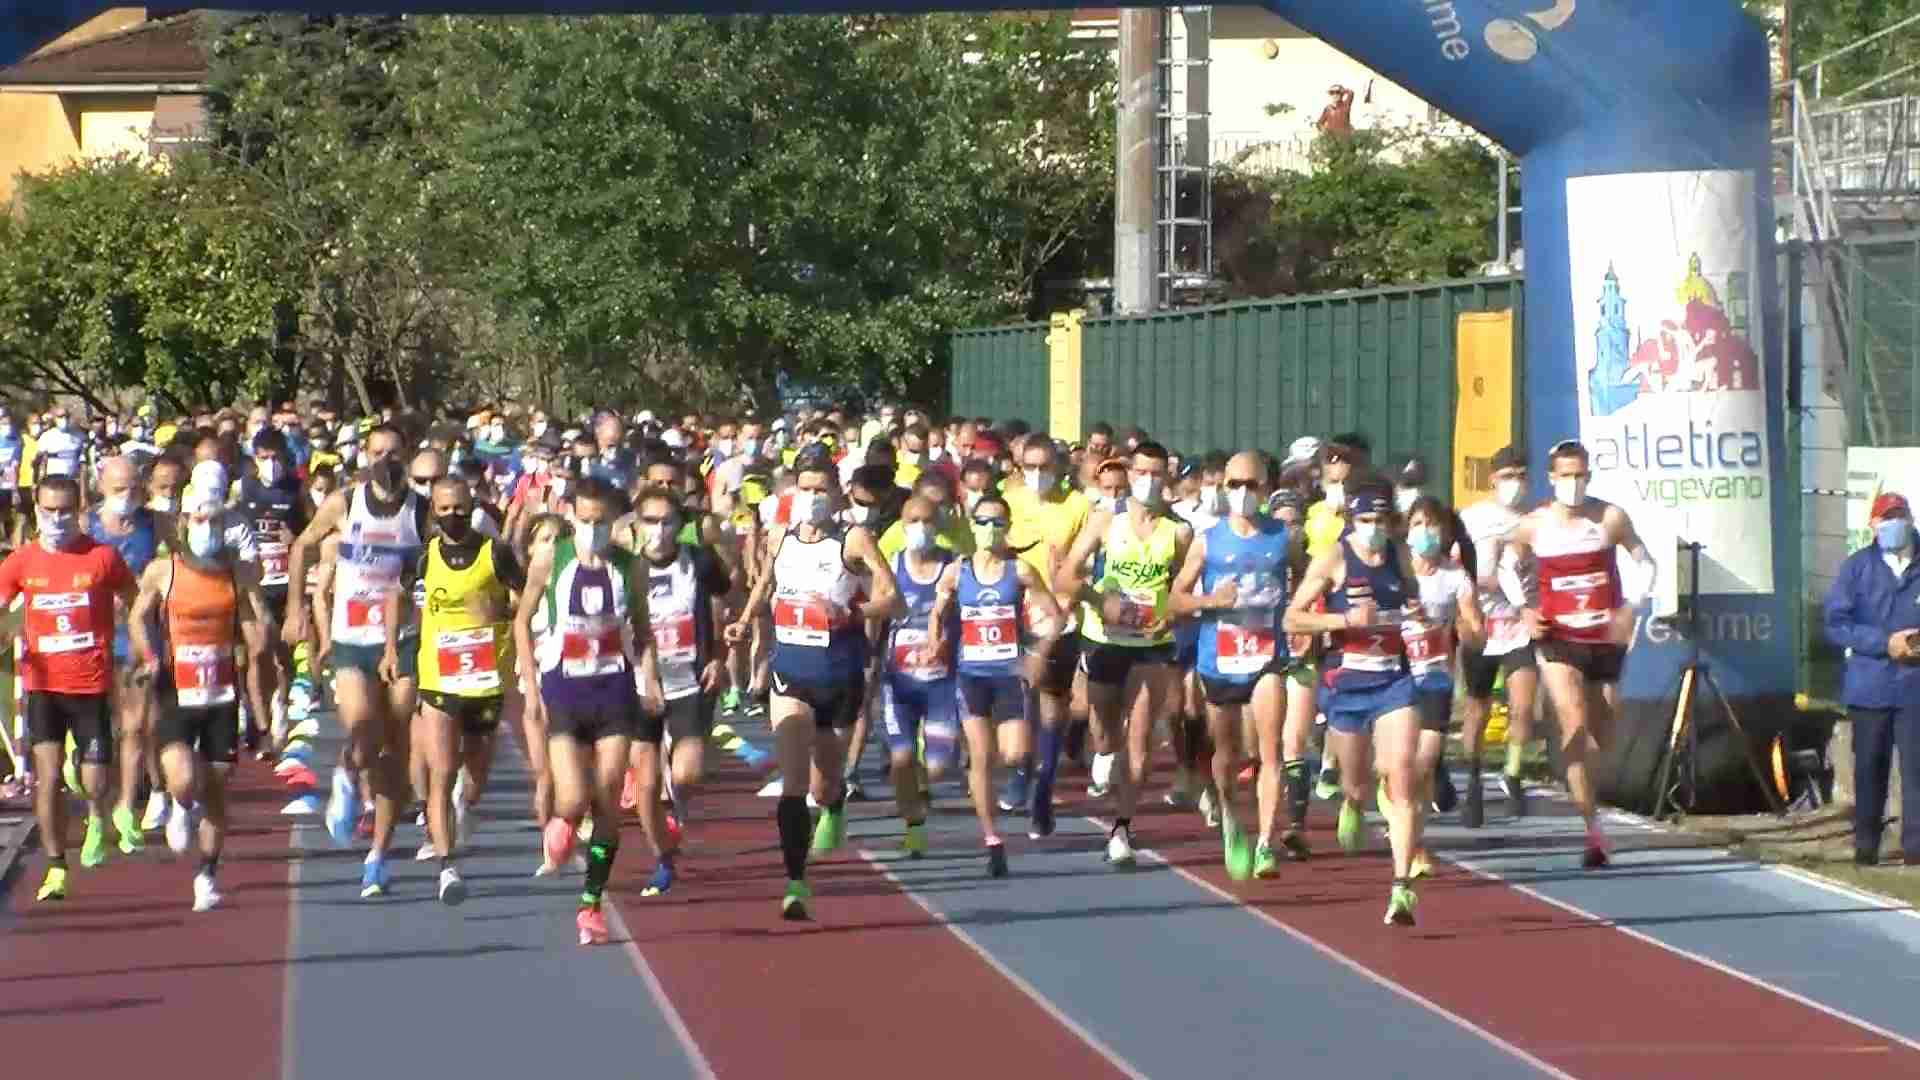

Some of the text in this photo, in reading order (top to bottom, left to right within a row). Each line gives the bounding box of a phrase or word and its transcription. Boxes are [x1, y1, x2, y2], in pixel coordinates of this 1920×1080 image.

[1595, 420, 1762, 470] atletica
[1633, 474, 1765, 509] vigevano
[55, 615, 71, 633] 8
[792, 607, 804, 626] 1
[977, 625, 1002, 645] 10
[1234, 633, 1259, 656] 14
[459, 652, 475, 673] 5
